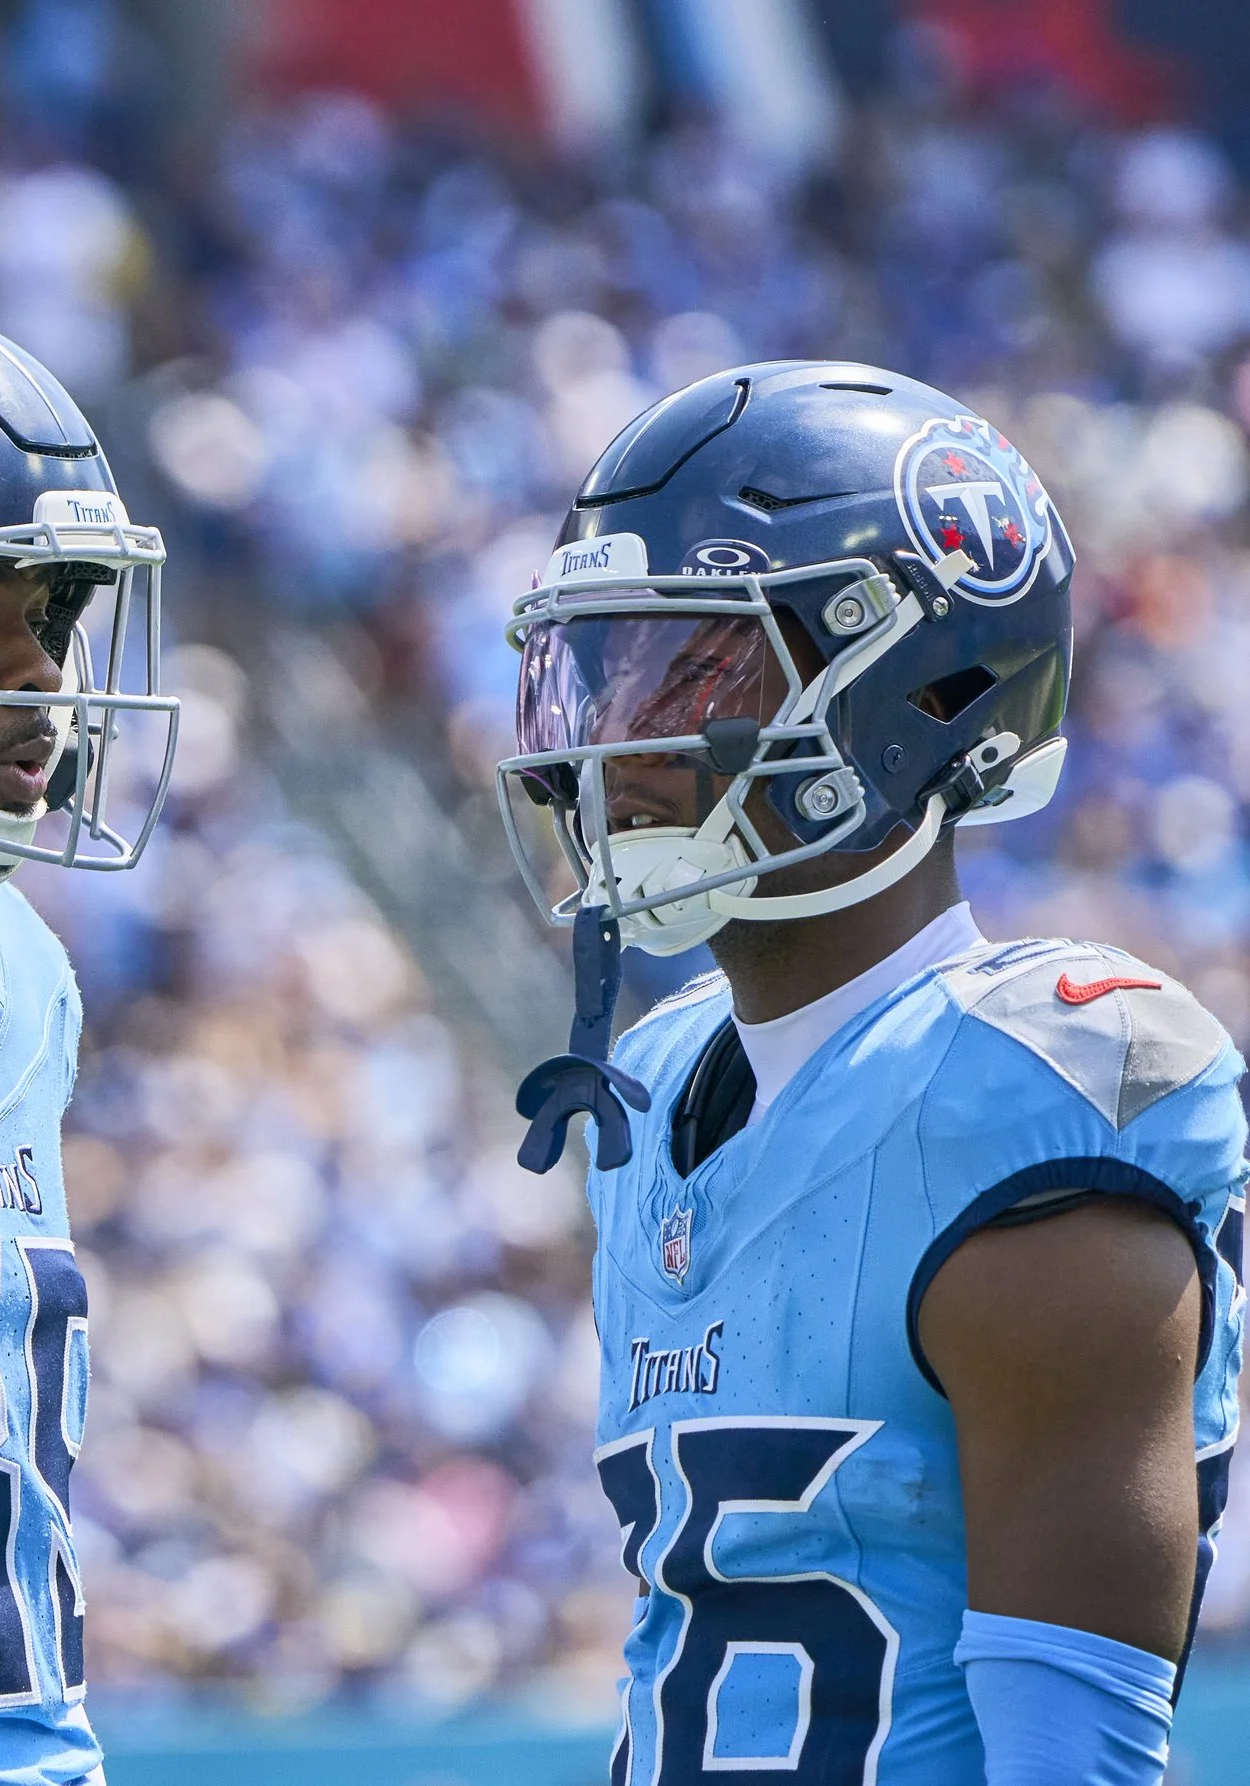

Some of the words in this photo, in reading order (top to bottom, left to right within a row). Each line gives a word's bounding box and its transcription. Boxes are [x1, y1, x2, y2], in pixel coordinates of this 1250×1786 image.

[67, 499, 116, 523] TITANS
[561, 542, 612, 576] TITANS
[665, 1238, 686, 1269] NFL
[628, 1319, 725, 1414] TITANS
